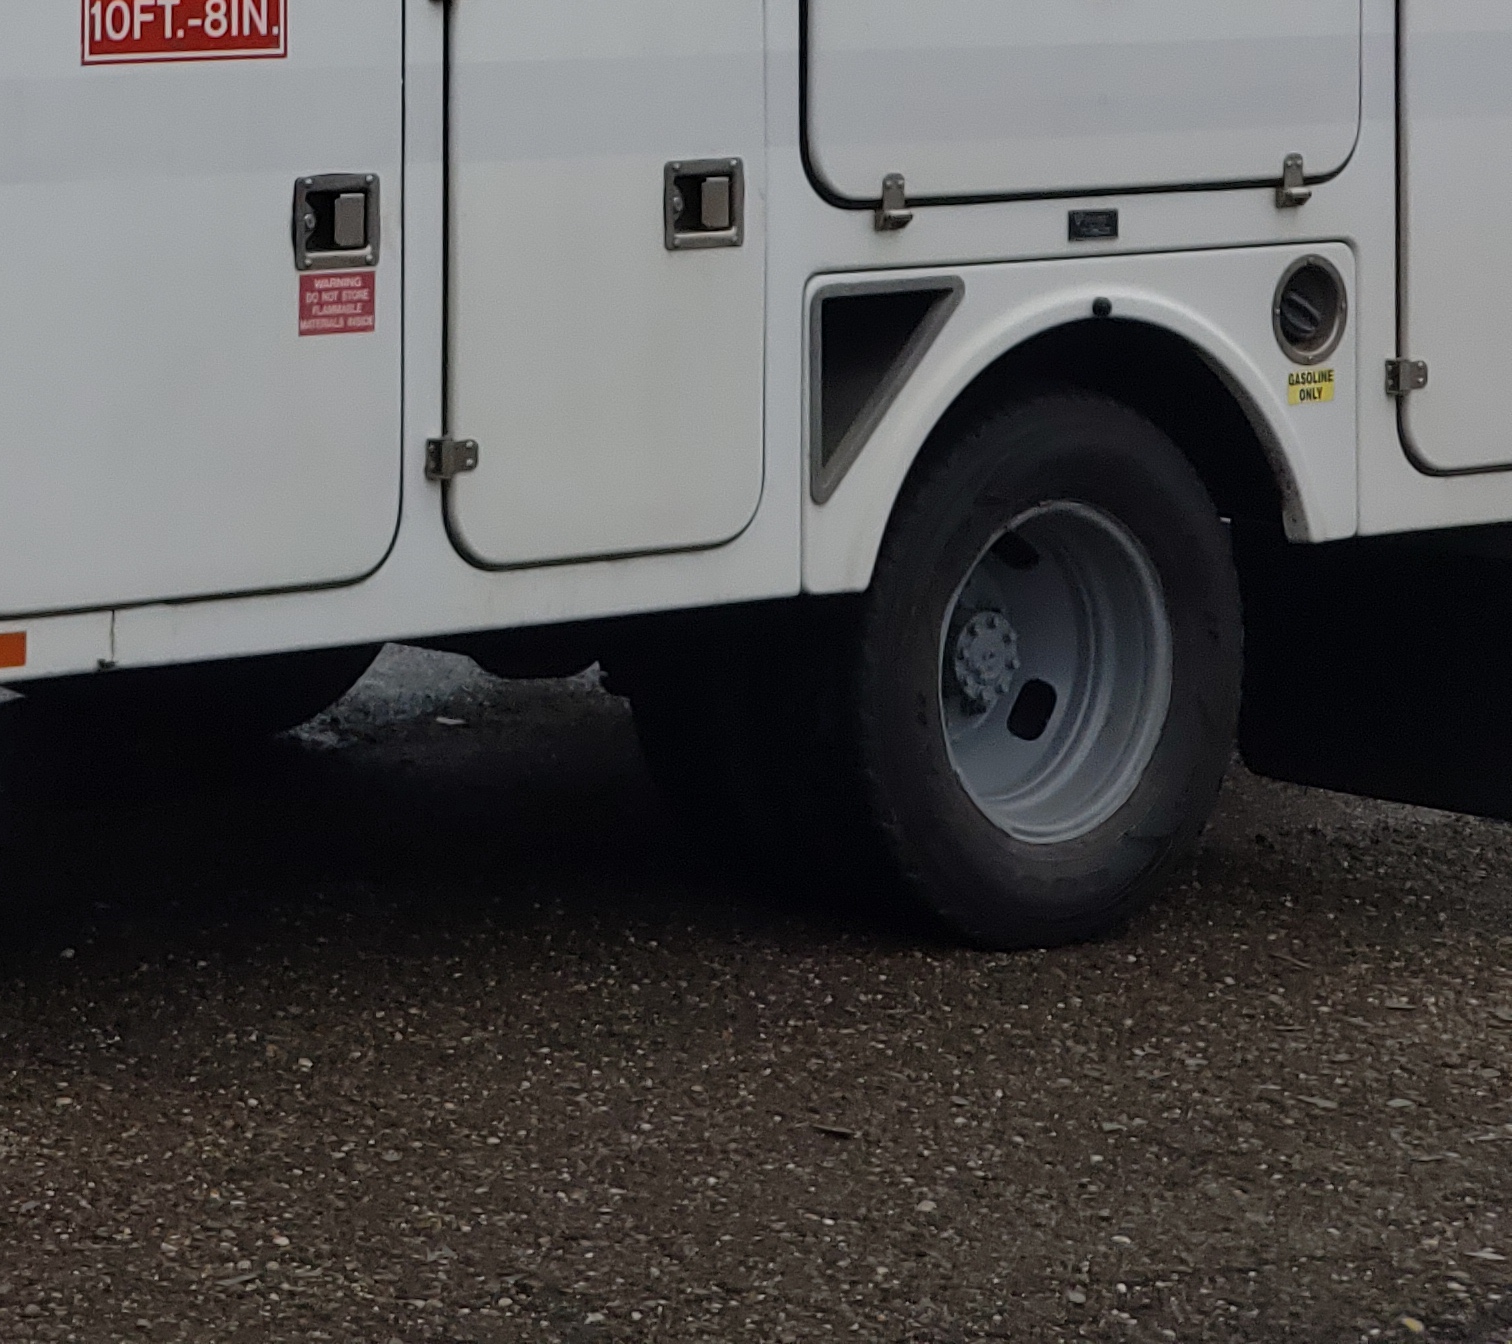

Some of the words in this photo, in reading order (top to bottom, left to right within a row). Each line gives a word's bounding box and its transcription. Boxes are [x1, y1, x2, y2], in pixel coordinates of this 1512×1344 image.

[314, 276, 362, 289] WARNING
[306, 292, 318, 303] DO
[322, 290, 338, 302] NOT
[342, 288, 369, 301] STORE
[1289, 370, 1334, 385] GASOLINE
[1299, 386, 1323, 402] ONLY
